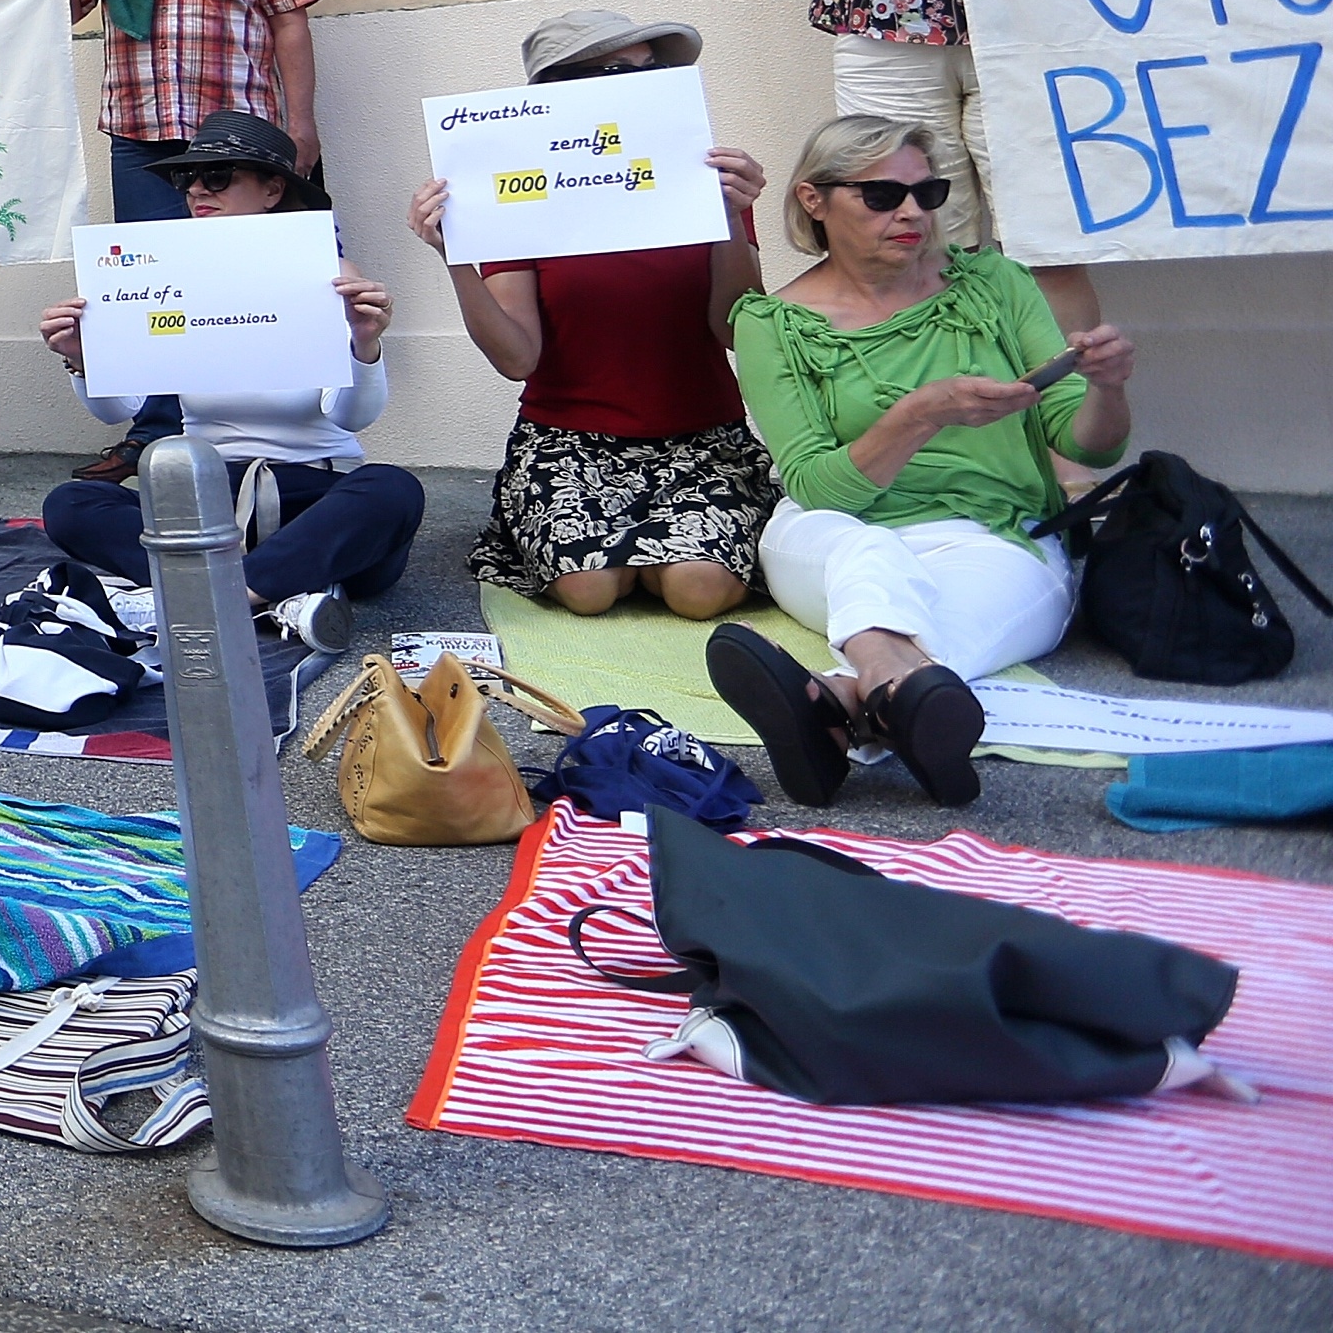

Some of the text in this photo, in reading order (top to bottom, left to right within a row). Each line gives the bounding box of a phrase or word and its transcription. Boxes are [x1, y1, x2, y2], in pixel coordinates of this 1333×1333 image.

[440, 100, 551, 130] Hrvatska:
[549, 129, 621, 156] zemlja
[1044, 42, 1333, 234] BEZ
[498, 167, 655, 195] 1000 koncesija
[97, 253, 159, 267] CROATIA
[101, 285, 183, 305] a land of a
[150, 312, 278, 329] 1000 concessions
